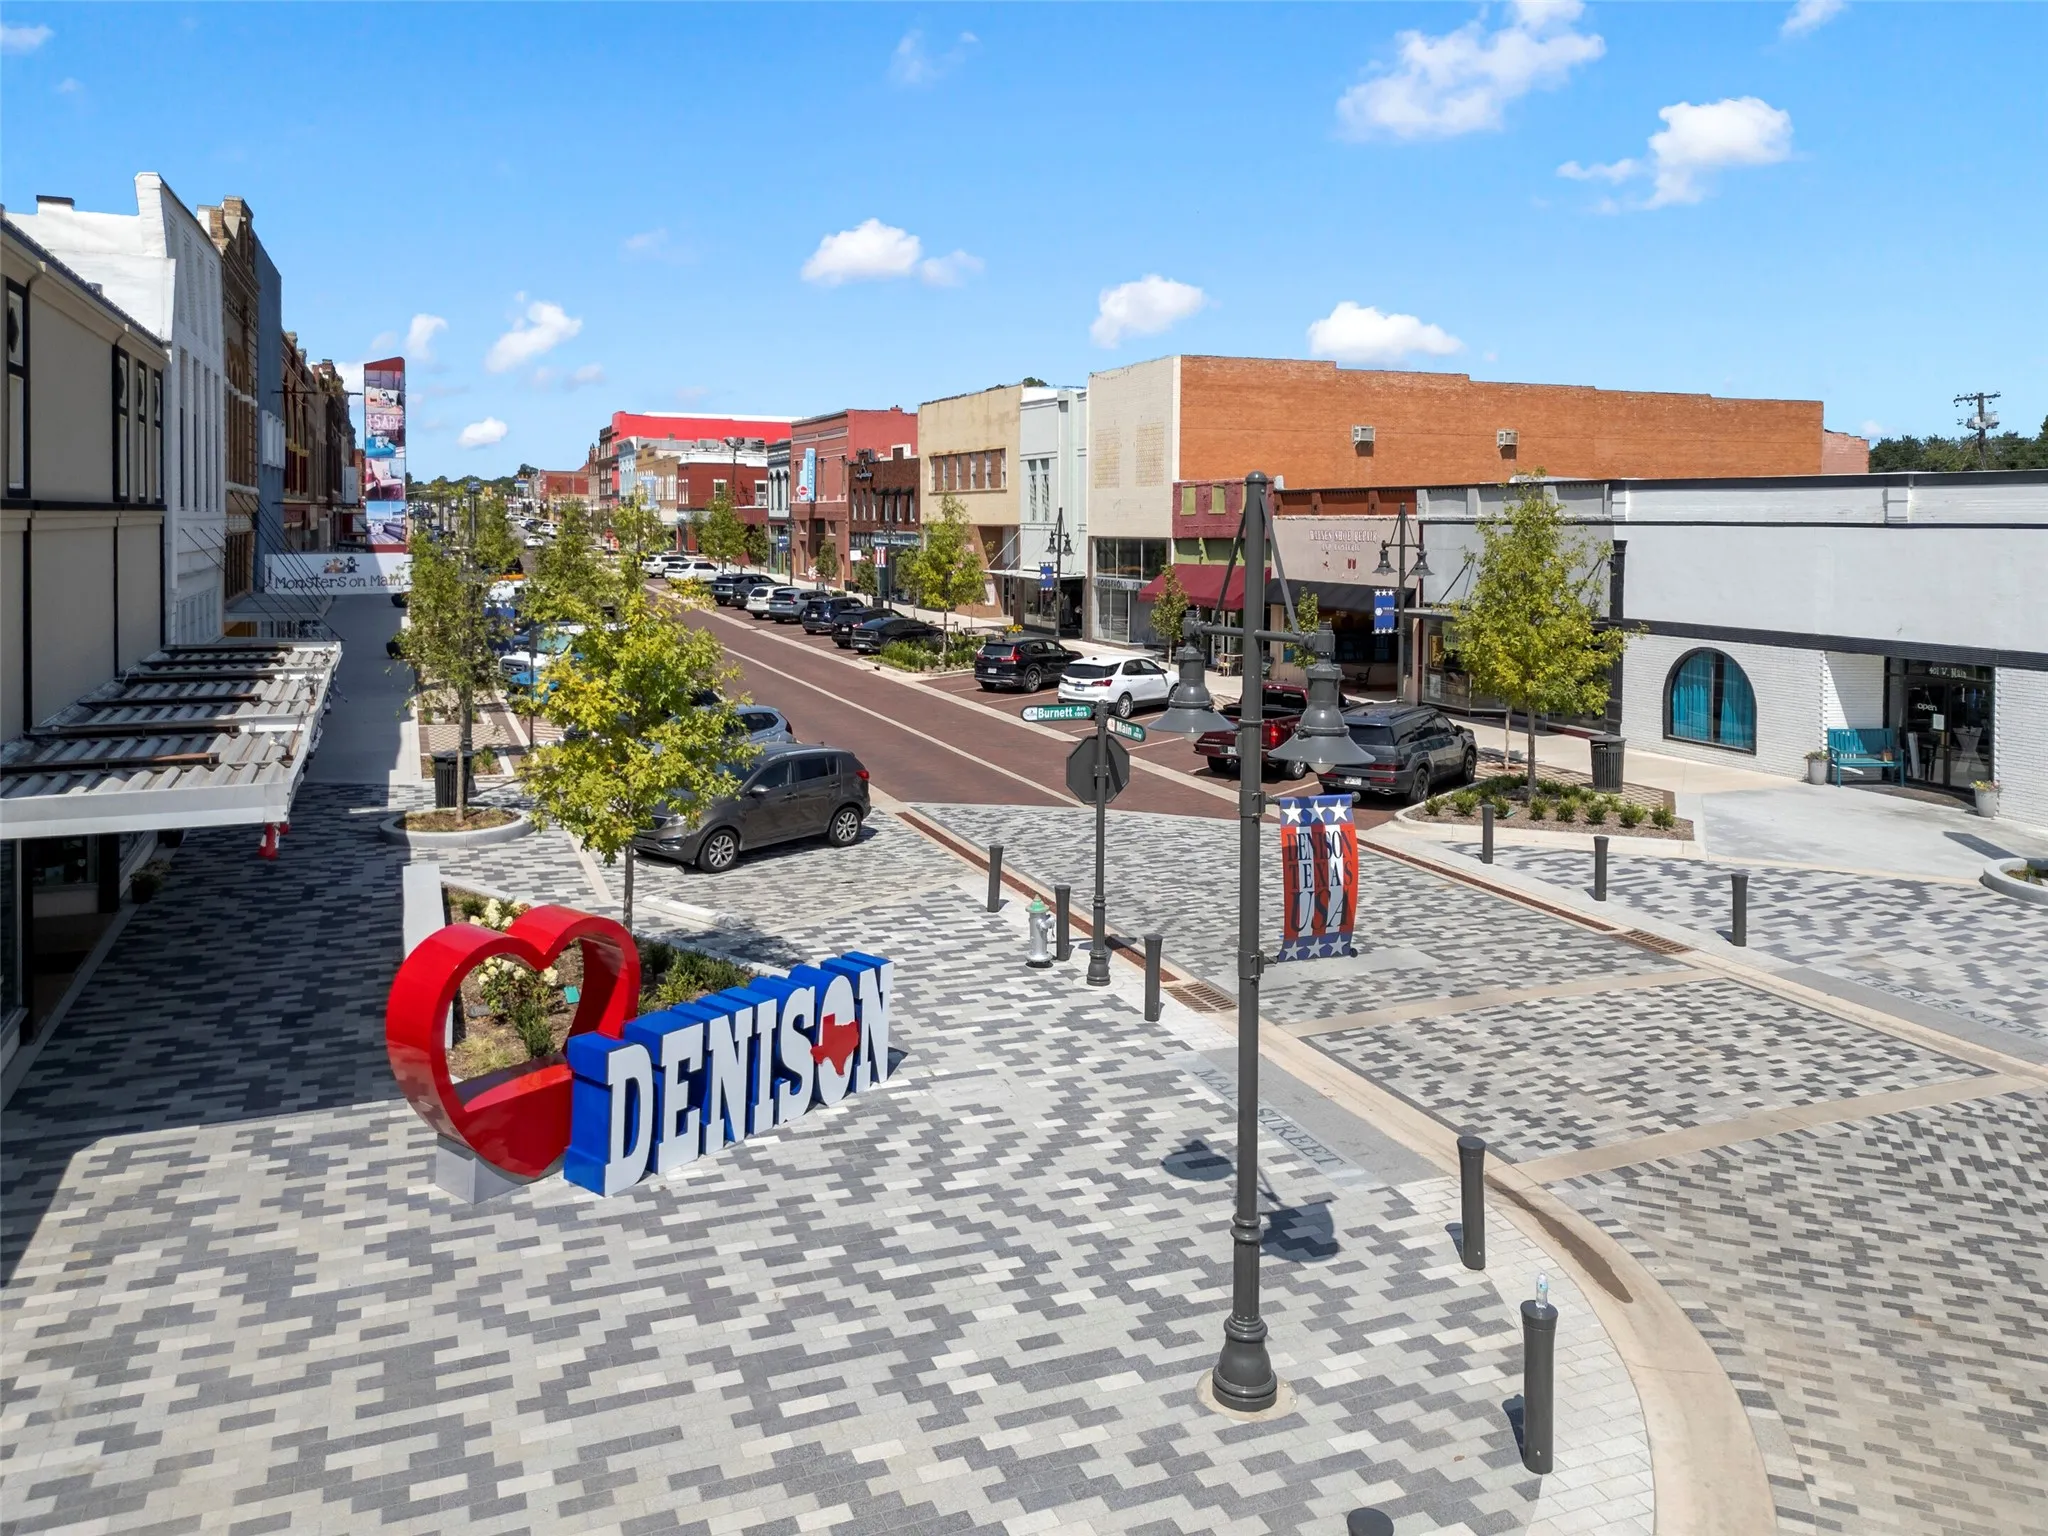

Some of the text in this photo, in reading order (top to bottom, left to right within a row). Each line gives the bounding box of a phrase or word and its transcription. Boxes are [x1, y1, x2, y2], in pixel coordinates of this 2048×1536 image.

[1334, 530, 1352, 542] SHOE
[1354, 530, 1377, 543] REPAIR
[275, 573, 347, 590] Monsters
[349, 578, 367, 588] on
[1097, 578, 1128, 589] HOUSEHOLD
[1951, 668, 1966, 678] Main
[1038, 706, 1073, 719] Burnett
[1917, 702, 1937, 711] open
[1116, 720, 1132, 736] Main
[1287, 830, 1353, 862] DENISON
[1289, 861, 1353, 891] TEXAS
[1290, 888, 1350, 933] USA
[603, 959, 894, 1197] DENISON
[1258, 1107, 1347, 1167] STREET
